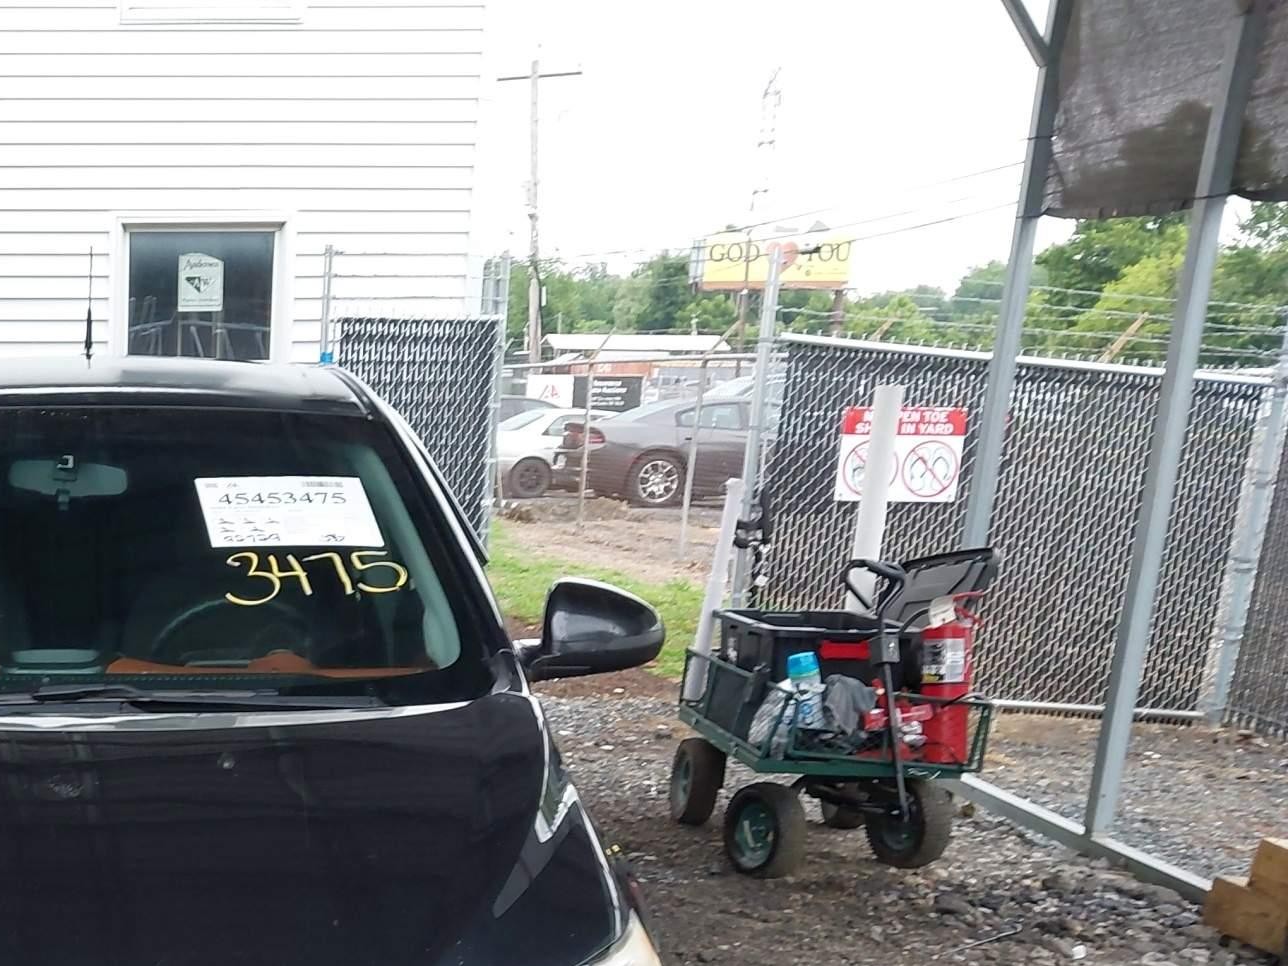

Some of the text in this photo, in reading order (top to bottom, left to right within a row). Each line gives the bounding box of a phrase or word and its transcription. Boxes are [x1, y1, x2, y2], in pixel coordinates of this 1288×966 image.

[710, 243, 760, 262] GOD
[899, 411, 920, 421] EN
[923, 411, 948, 421] TOE
[900, 423, 954, 434] IN YARD
[218, 492, 347, 505] 45453475
[225, 551, 408, 606] 3475
